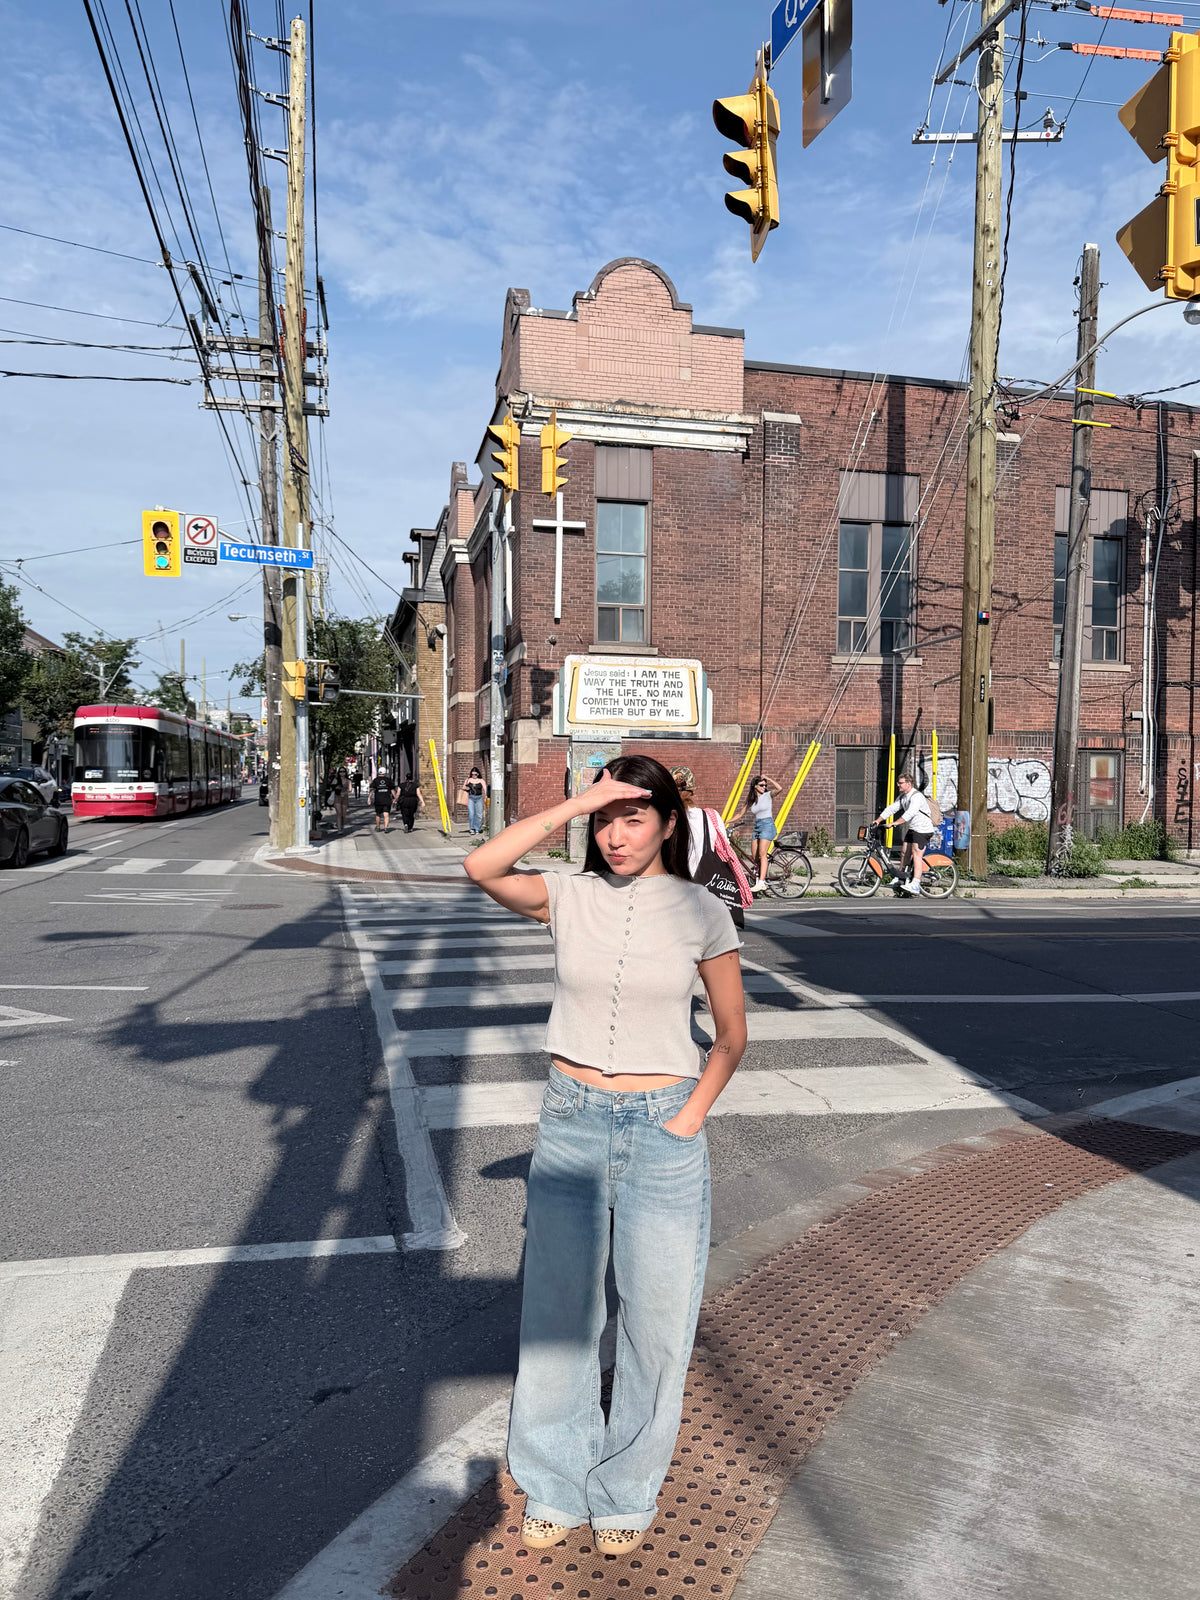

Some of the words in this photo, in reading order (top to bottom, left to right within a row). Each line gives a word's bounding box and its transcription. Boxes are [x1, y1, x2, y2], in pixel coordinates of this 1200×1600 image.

[186, 549, 215, 557] BICYCLES
[223, 544, 297, 563] Tecumseth
[302, 551, 310, 559] St
[185, 555, 216, 564] EXCEPTED
[584, 668, 608, 677] Jesus
[633, 670, 637, 678] I
[641, 670, 657, 679] AM
[662, 671, 681, 679] THE
[584, 678, 605, 687] WAY
[609, 678, 627, 687] THE
[630, 679, 660, 688] TRUTH
[663, 680, 684, 689] AND
[596, 688, 614, 697] THE
[646, 689, 660, 698] NO
[663, 690, 684, 698] MAN
[582, 697, 620, 706] COMETH
[623, 698, 648, 707] UNTO
[652, 699, 669, 707] THE
[589, 707, 624, 716] FATHER
[627, 708, 645, 717] BUT
[649, 709, 662, 717] BY
[665, 709, 685, 717] ME.
